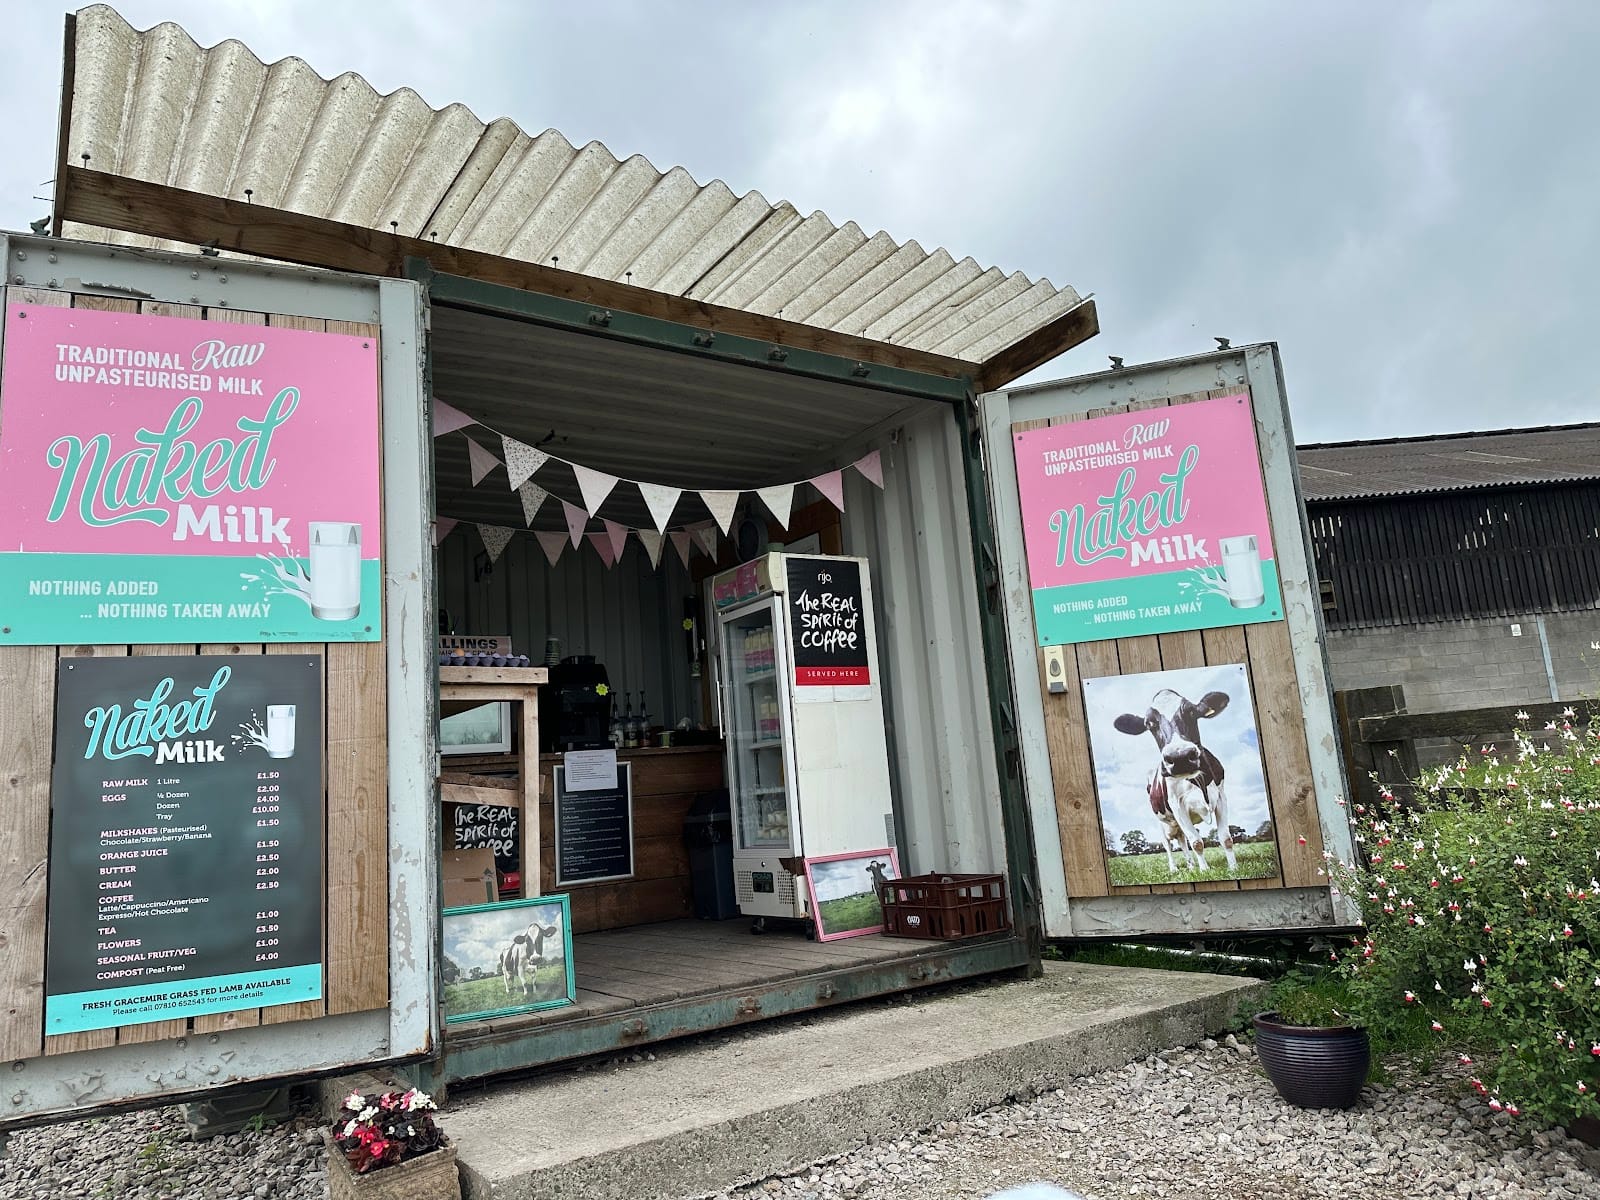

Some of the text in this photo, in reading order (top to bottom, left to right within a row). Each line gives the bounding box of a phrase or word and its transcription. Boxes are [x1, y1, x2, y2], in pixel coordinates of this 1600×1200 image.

[56, 340, 265, 372] TRADITIONAL Raw
[55, 364, 264, 395] UNPASTEURISED MILK
[1043, 418, 1170, 464] TRADITIONAL Raw
[46, 386, 300, 528] Naked
[1044, 445, 1174, 477] UNPASTEURISED MILK
[1049, 445, 1199, 567] Naked
[172, 504, 291, 544] Milk
[1130, 534, 1209, 567] Milk
[29, 580, 158, 596] NOTHING ADDED
[795, 589, 857, 613] The REAL
[1053, 596, 1128, 614] NOTHING ADDED
[98, 602, 168, 618] NOTHING
[172, 603, 223, 618] TAKEN
[227, 603, 271, 618] AWAY
[1094, 609, 1136, 624] NOTHING
[1139, 606, 1170, 620] TAKEN
[1173, 602, 1202, 616] AWAY
[844, 613, 858, 631] of
[439, 639, 498, 649] LLINGS
[84, 665, 232, 760] Naked
[155, 740, 225, 765] Milk
[102, 780, 123, 788] RAW
[102, 794, 126, 802] EGGS
[252, 805, 279, 813] £10.00
[476, 806, 516, 823] REAL
[100, 824, 207, 838] MILKSHAKES (Pasteurised)
[501, 821, 517, 838] of
[100, 833, 212, 846] Chocolate/Strawberry/Banana
[256, 840, 279, 848] £1.50
[100, 848, 168, 860] ORANGE JUICE
[100, 866, 136, 875] BUTTER
[99, 880, 132, 889] CREAM
[256, 881, 279, 889] £2.50
[98, 897, 209, 912] Latte/Cappuccino/Americano
[99, 895, 134, 904] COFFEE
[98, 906, 189, 921] Expresso/Hot Chocolate
[256, 910, 279, 919] £1.00
[98, 927, 116, 935] TEA
[256, 924, 279, 933] £3.50
[97, 939, 141, 950] FLOWERS
[256, 938, 279, 947] £1.00
[97, 948, 197, 965] SEASONAL FRUIT/VEG
[256, 952, 279, 961] £4.00
[96, 964, 185, 980] COMPOST (Peat Free)
[82, 978, 291, 1010] FRESH GRACEMIRE GRASS FED LAMB AVAILABLE
[139, 1004, 153, 1012] call
[240, 991, 264, 999] details
